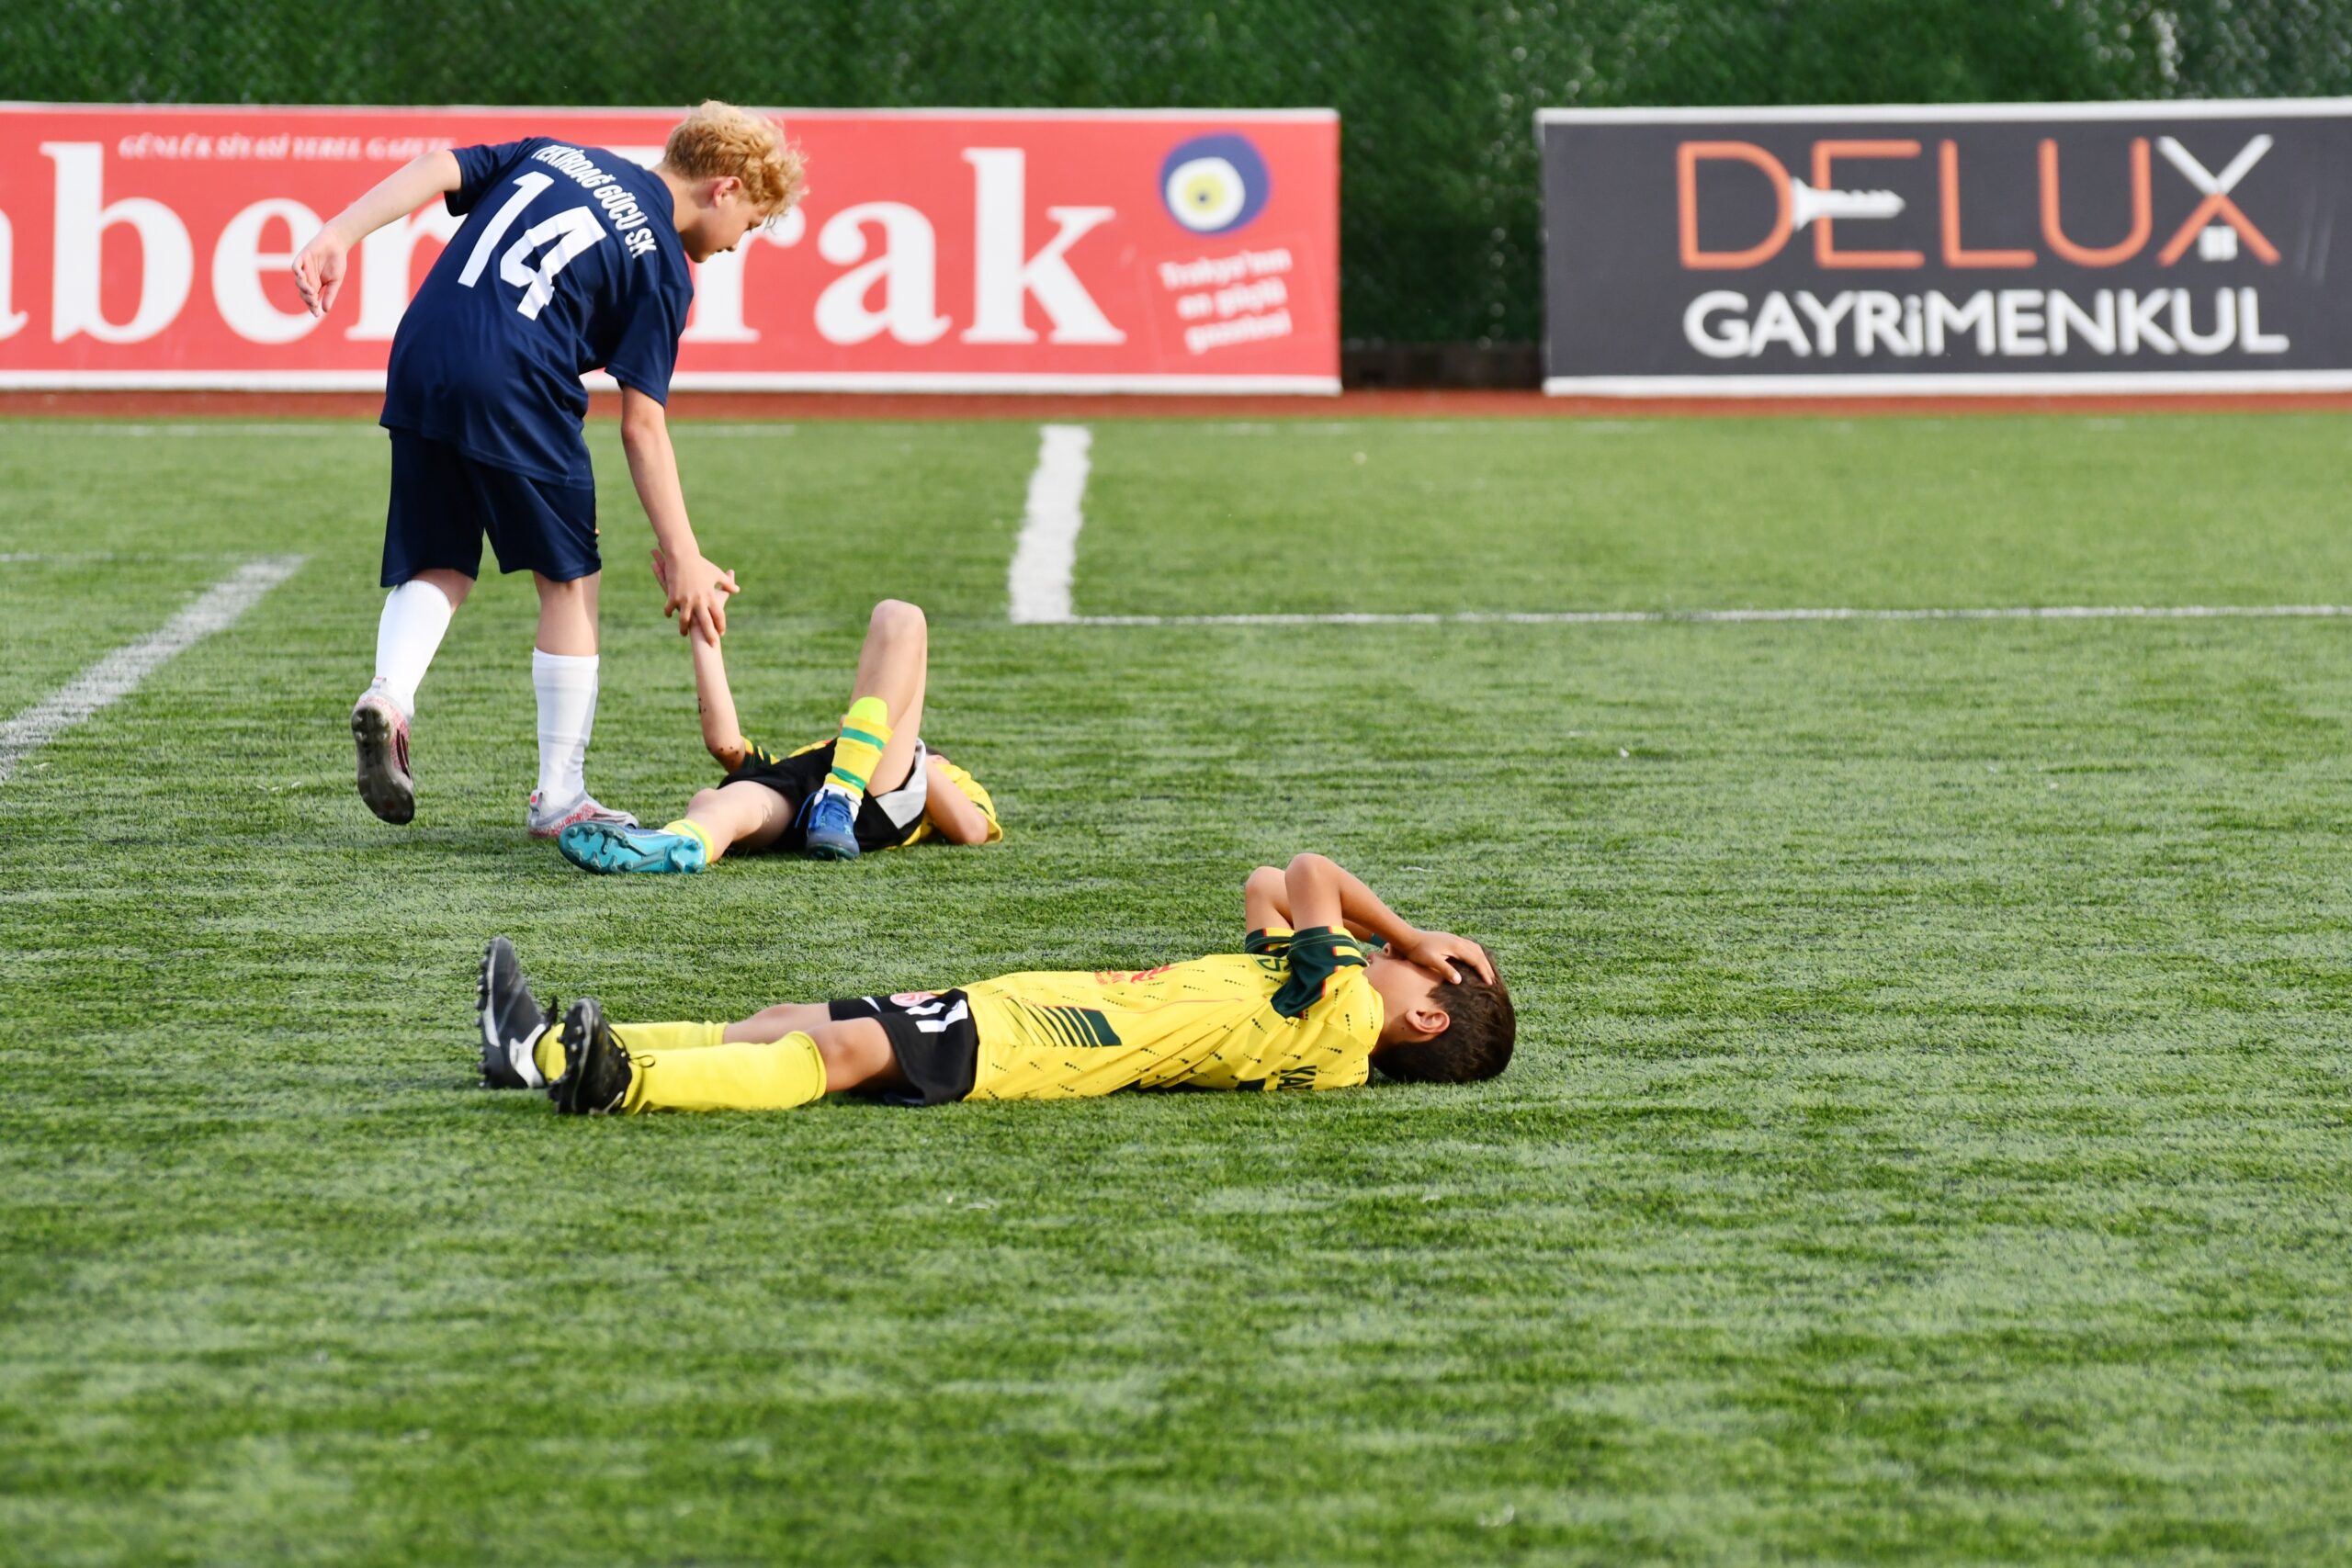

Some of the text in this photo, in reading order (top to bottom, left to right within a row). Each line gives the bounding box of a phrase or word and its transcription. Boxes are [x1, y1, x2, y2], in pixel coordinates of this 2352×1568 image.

[458, 171, 607, 321] 14
[625, 228, 657, 259] SK
[1677, 134, 2279, 269] DELUX
